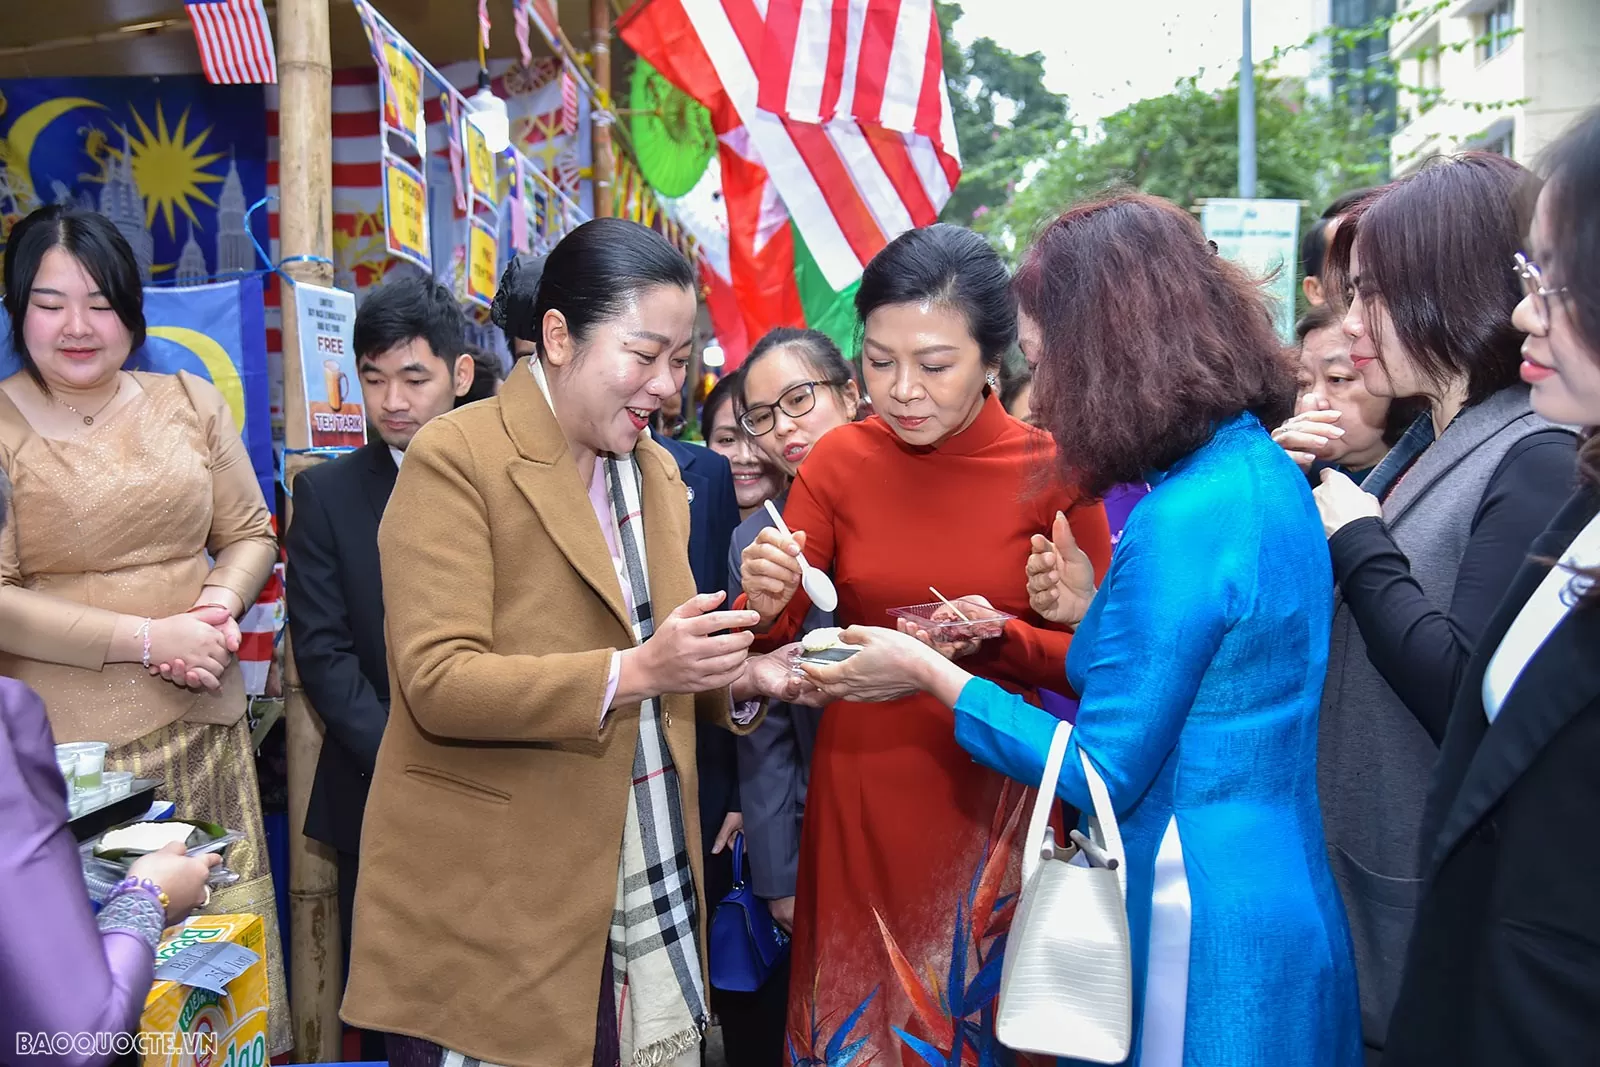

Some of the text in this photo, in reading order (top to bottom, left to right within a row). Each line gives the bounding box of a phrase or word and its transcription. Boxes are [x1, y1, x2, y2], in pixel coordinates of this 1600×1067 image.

[317, 336, 344, 355] FREE
[314, 413, 362, 432] TEH TARIK
